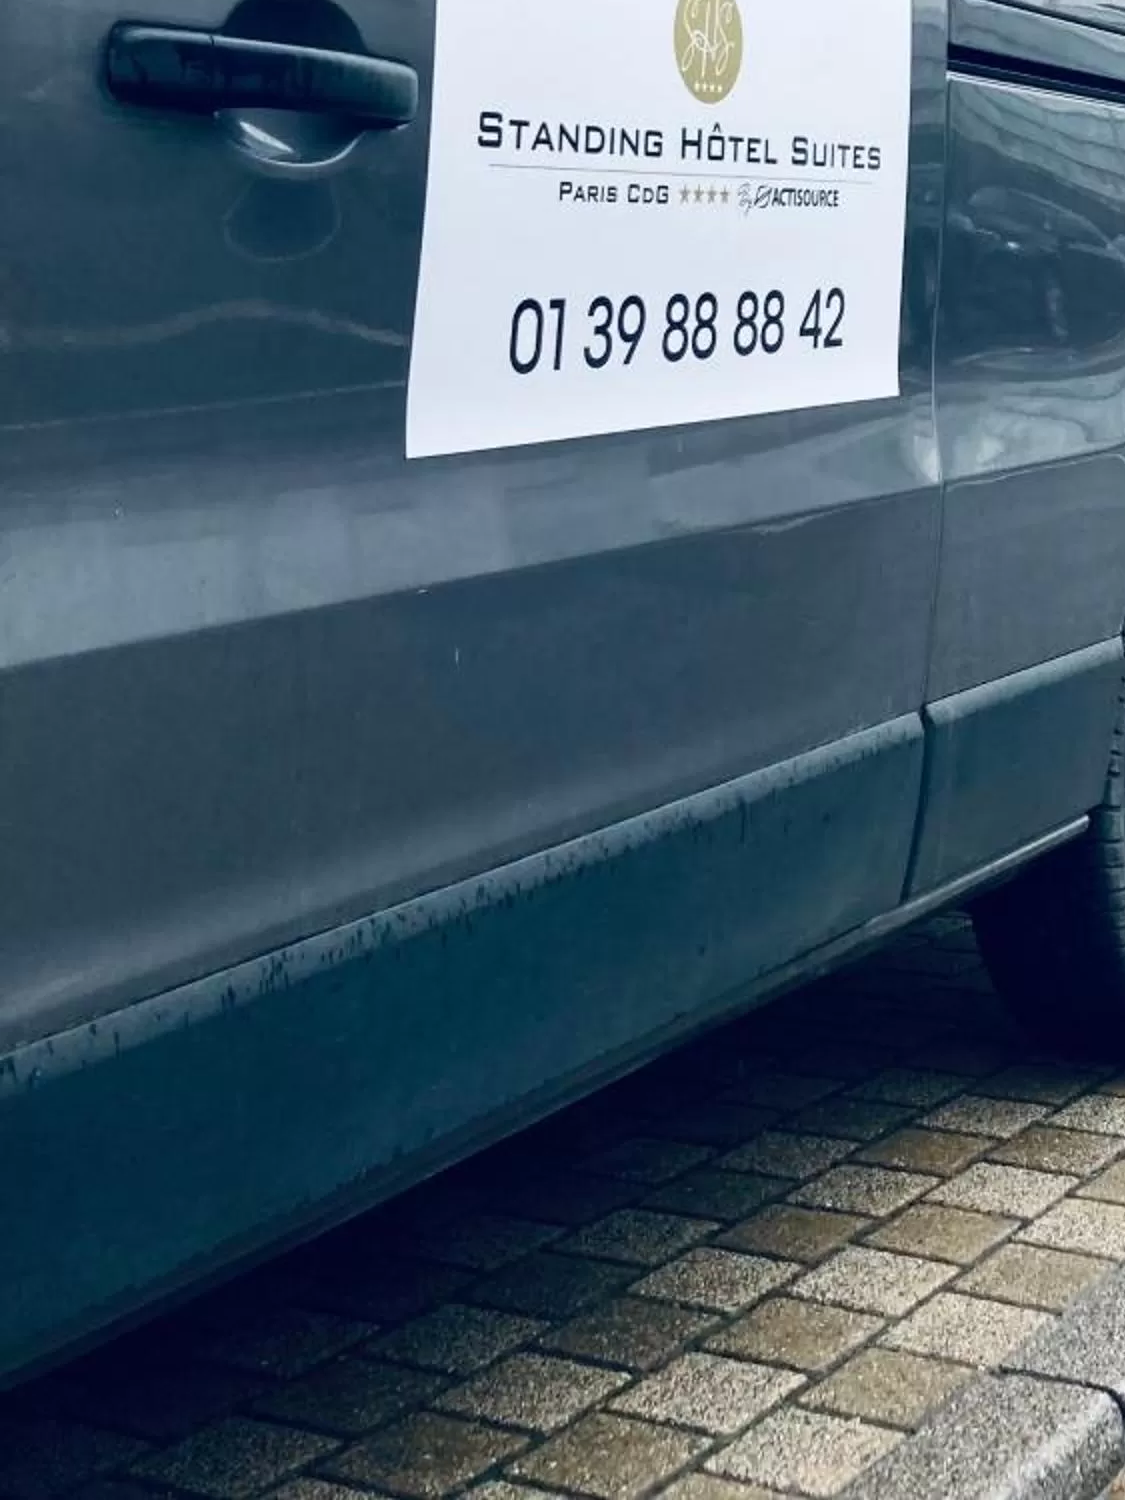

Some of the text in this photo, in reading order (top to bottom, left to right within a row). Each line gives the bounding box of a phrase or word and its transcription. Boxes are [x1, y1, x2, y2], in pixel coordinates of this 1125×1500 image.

[771, 186, 839, 208] ACTISOURCE
[508, 287, 846, 374] 01 39 88 88 42
